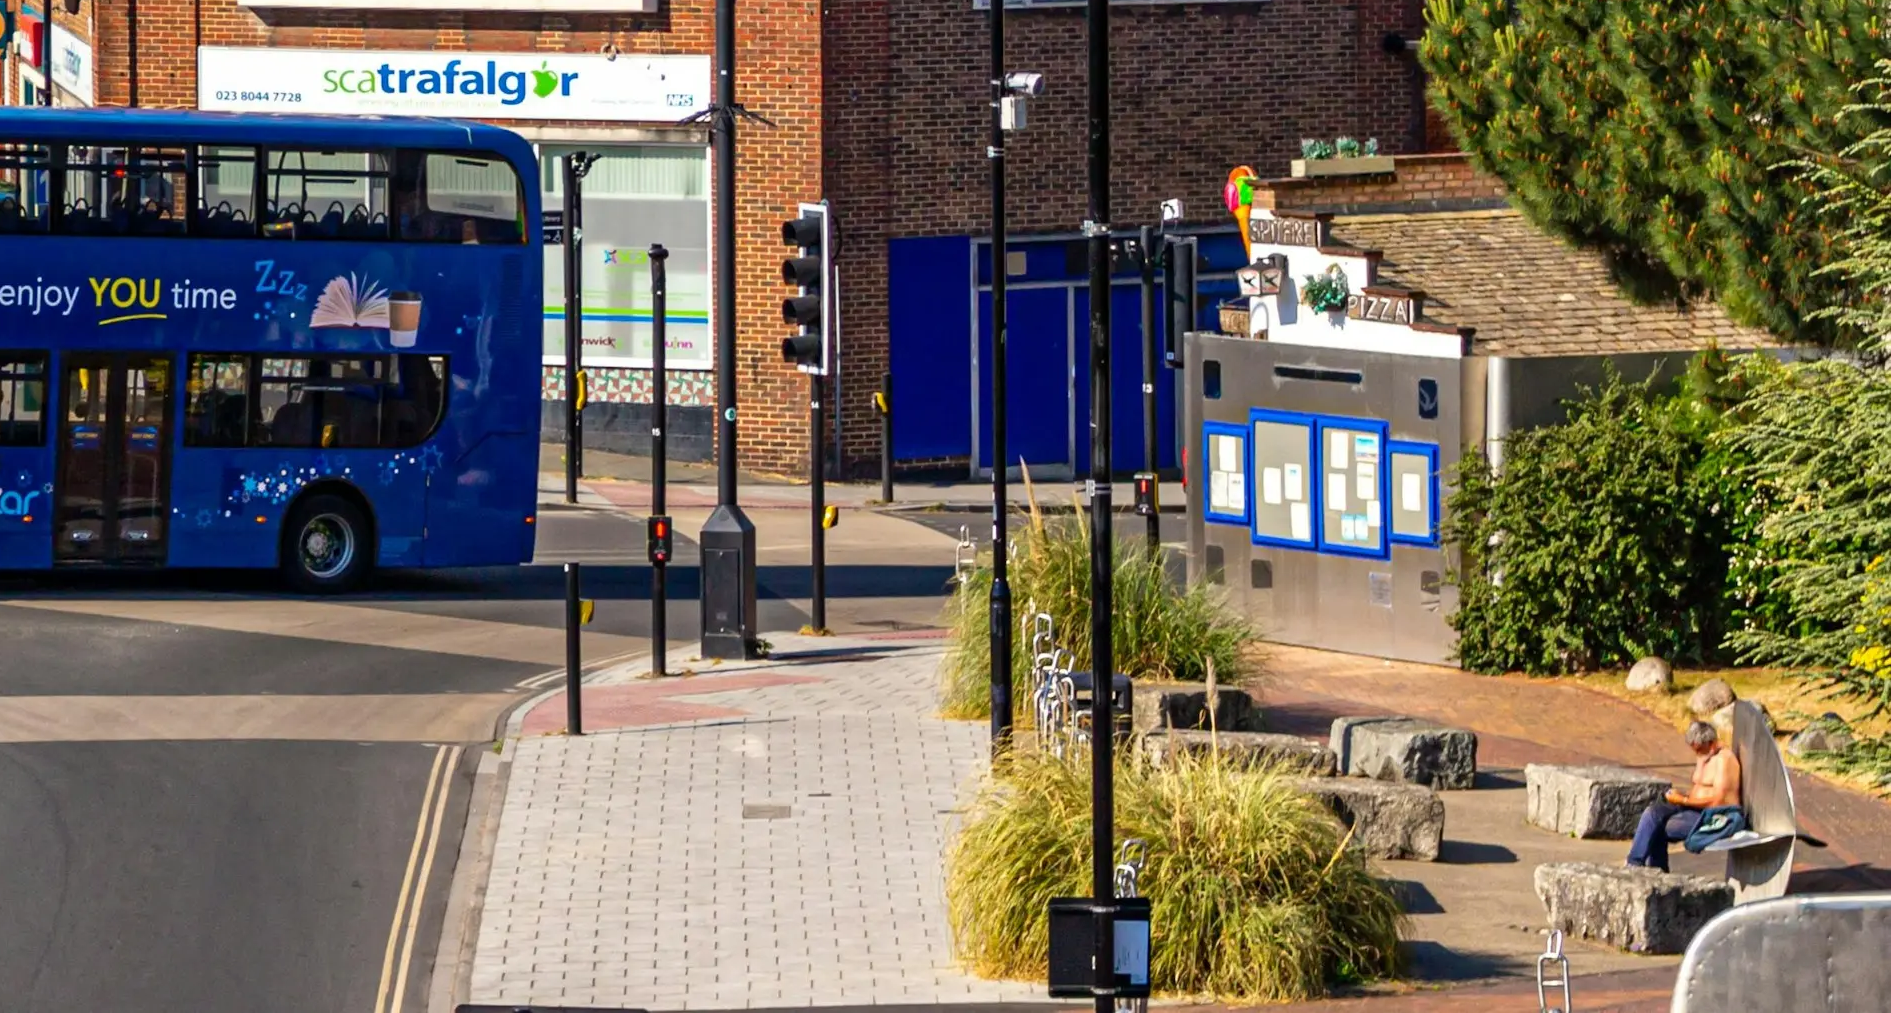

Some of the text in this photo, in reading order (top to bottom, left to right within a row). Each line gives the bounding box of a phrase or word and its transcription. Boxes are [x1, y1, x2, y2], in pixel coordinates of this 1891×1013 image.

[215, 90, 302, 103] 023 8044 7728
[667, 94, 693, 107] NHS
[88, 277, 161, 308] YOU
[171, 280, 237, 310] time
[1349, 295, 1407, 323] PIZZA
